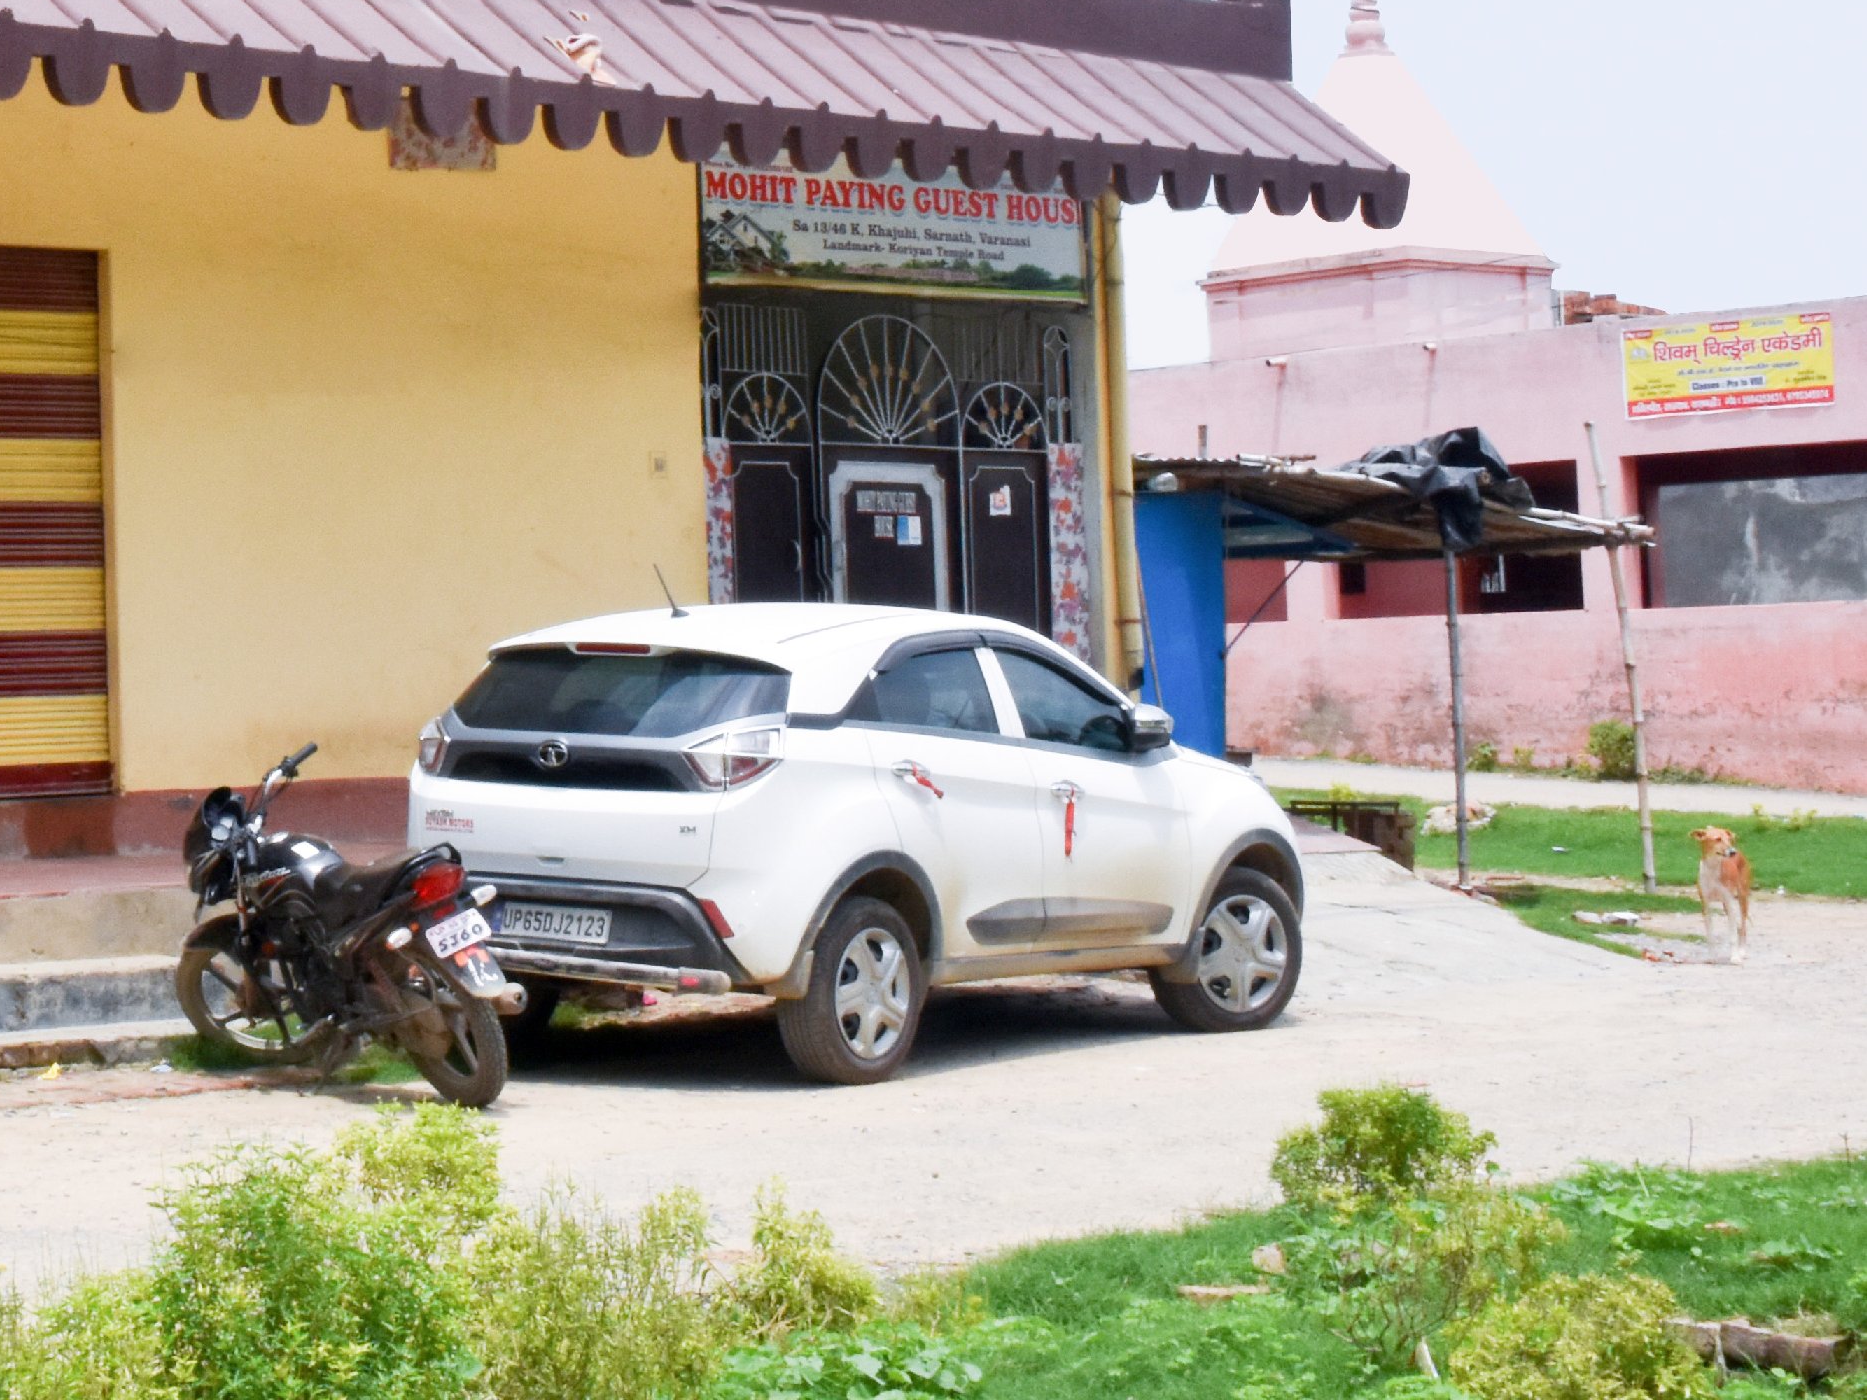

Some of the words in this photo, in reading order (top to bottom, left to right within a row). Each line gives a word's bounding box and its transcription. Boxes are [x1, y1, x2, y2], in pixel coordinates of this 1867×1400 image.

[705, 170, 797, 203] MOHIT
[805, 178, 906, 212] PAYING
[914, 188, 999, 220] GUEST
[792, 219, 809, 232] Sa
[979, 232, 1031, 248] Varanasi
[822, 238, 886, 253] Landmark-
[936, 245, 975, 260] Temple
[978, 248, 1005, 261] Road
[1653, 341, 1702, 365] शिवम्
[1761, 326, 1822, 353] एकेडमी
[503, 906, 608, 940] UP65DJ2123
